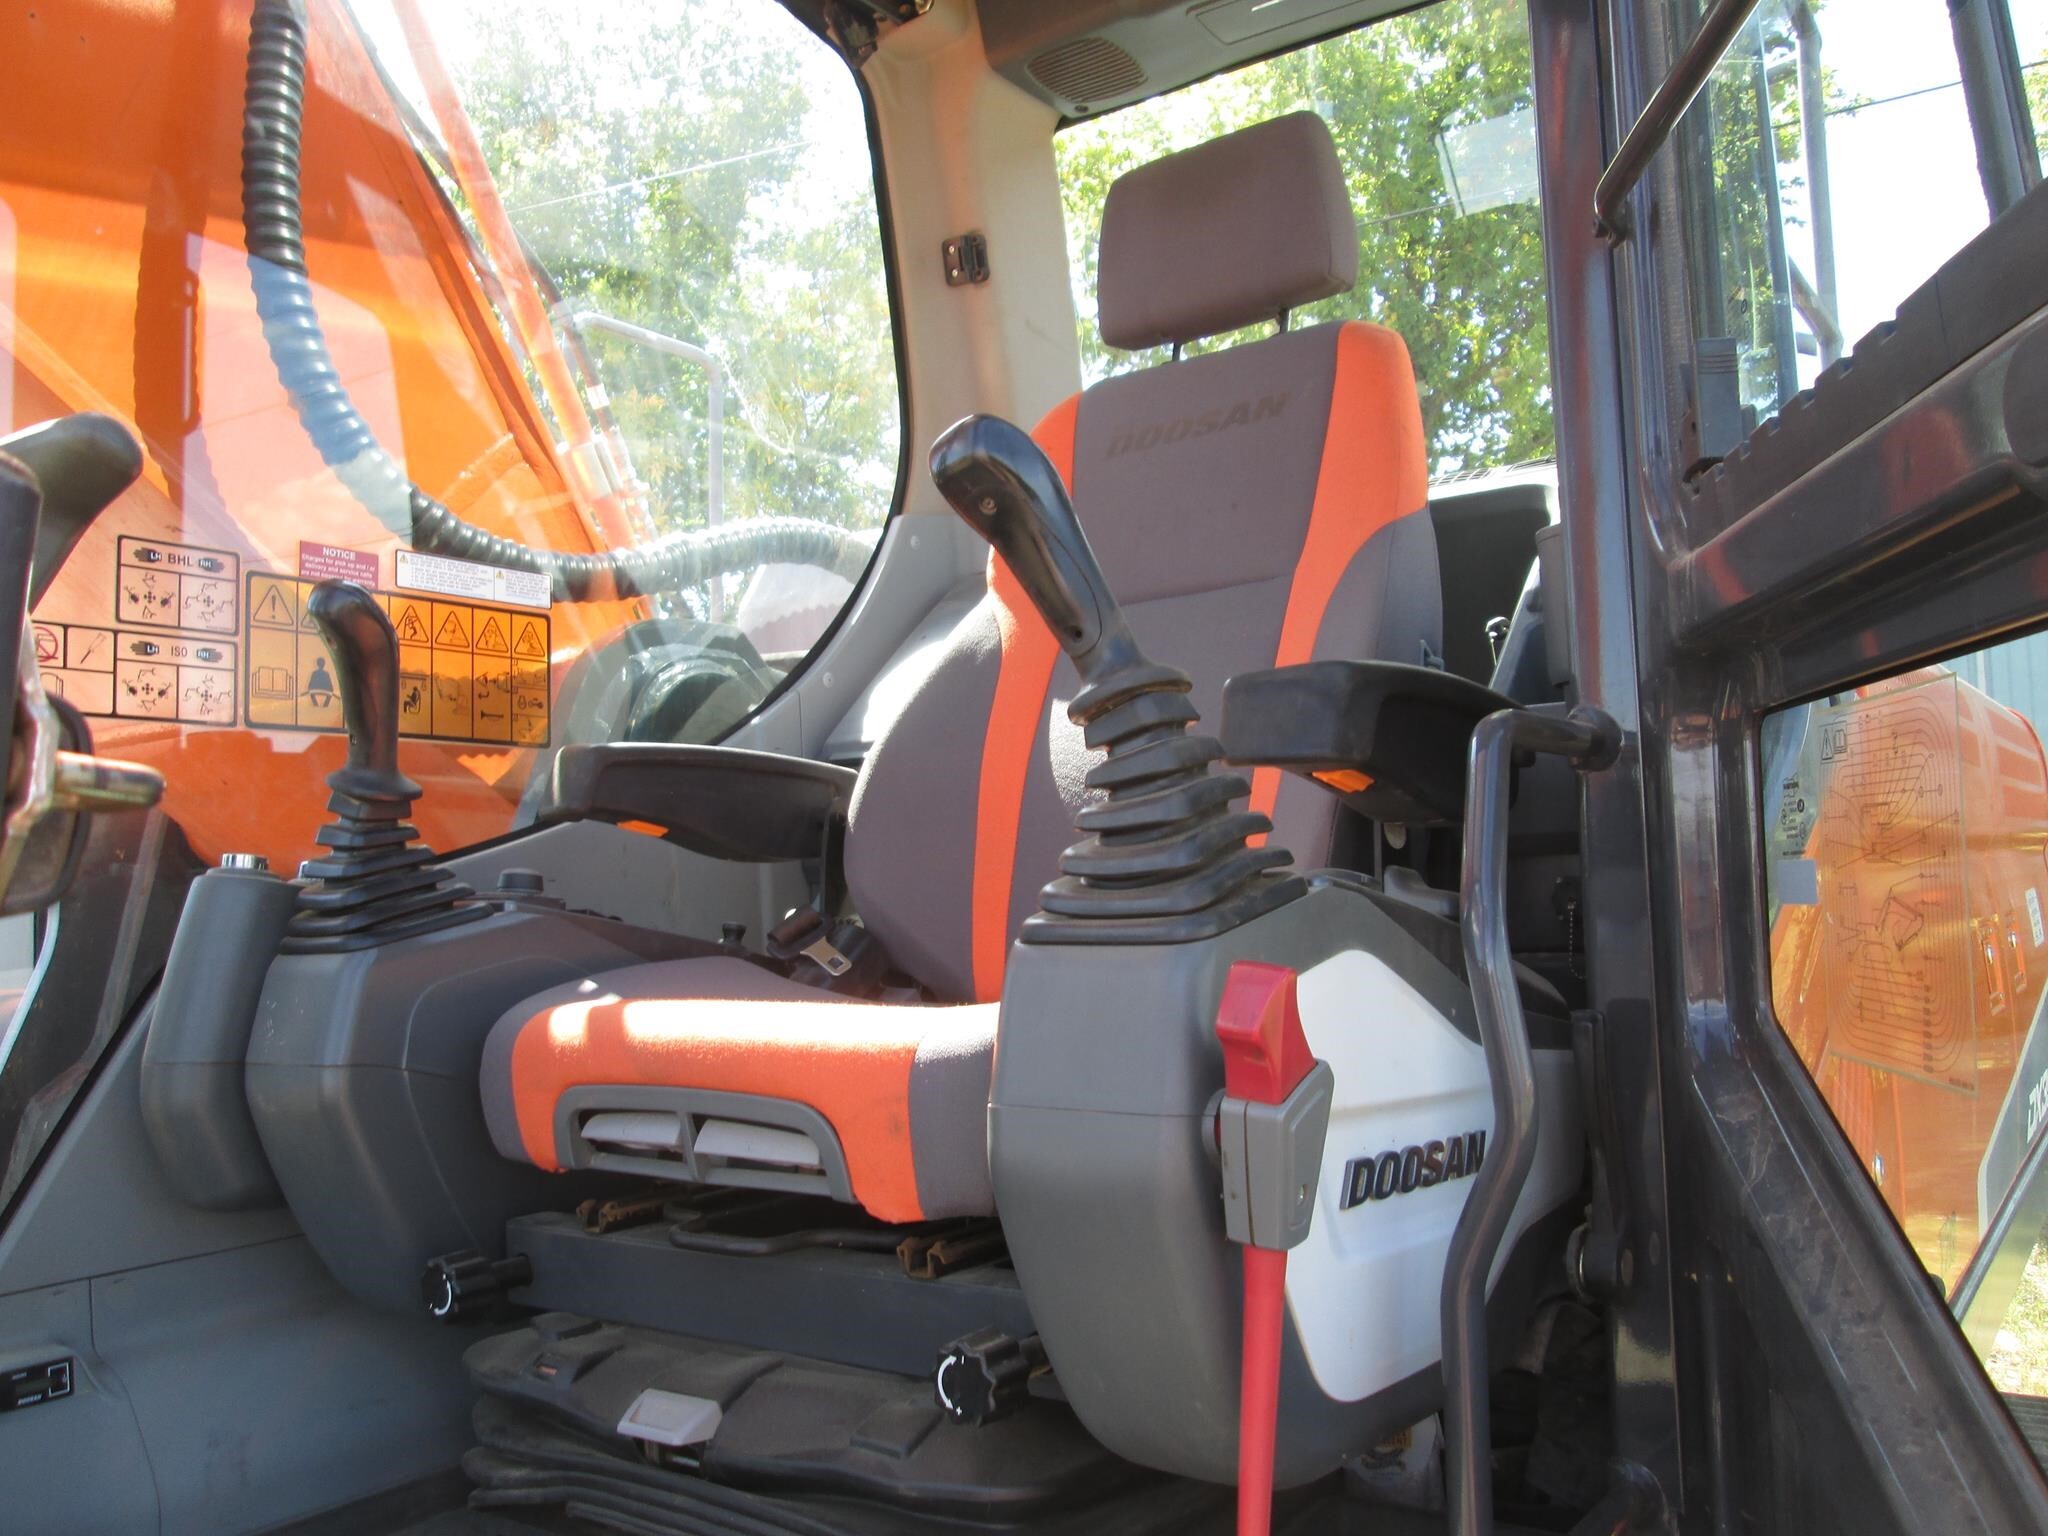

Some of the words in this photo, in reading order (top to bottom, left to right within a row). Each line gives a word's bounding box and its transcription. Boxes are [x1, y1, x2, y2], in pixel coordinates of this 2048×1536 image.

[1104, 391, 1289, 460] DOOSAN
[151, 552, 161, 560] LH
[168, 553, 193, 567] BHL
[200, 559, 212, 568] RH
[323, 546, 356, 561] NOTICE
[305, 561, 326, 571] delivery
[327, 565, 337, 573] and
[334, 559, 345, 567] pick
[147, 645, 158, 654] LH
[171, 646, 188, 657] ISO
[197, 650, 209, 658] RH
[1339, 1130, 1487, 1210] DOOSAN
